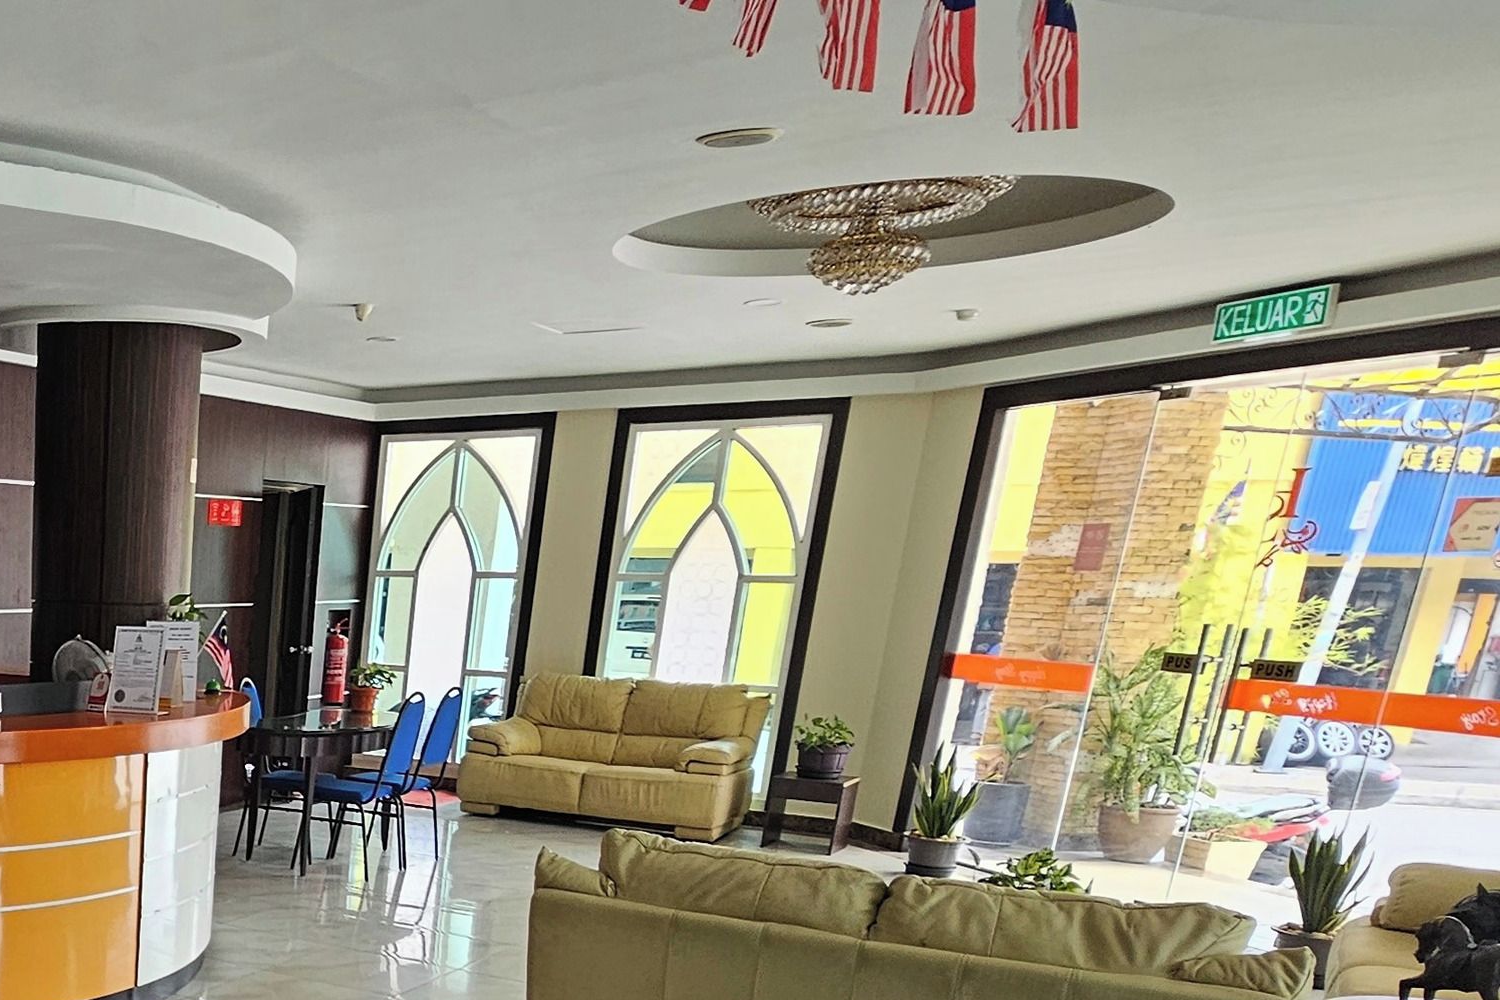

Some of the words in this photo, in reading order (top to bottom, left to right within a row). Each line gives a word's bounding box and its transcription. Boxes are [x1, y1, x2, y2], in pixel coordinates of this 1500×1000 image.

[1216, 295, 1303, 338] KELUAR
[1165, 655, 1193, 670] PUS
[1255, 662, 1296, 679] PUSH
